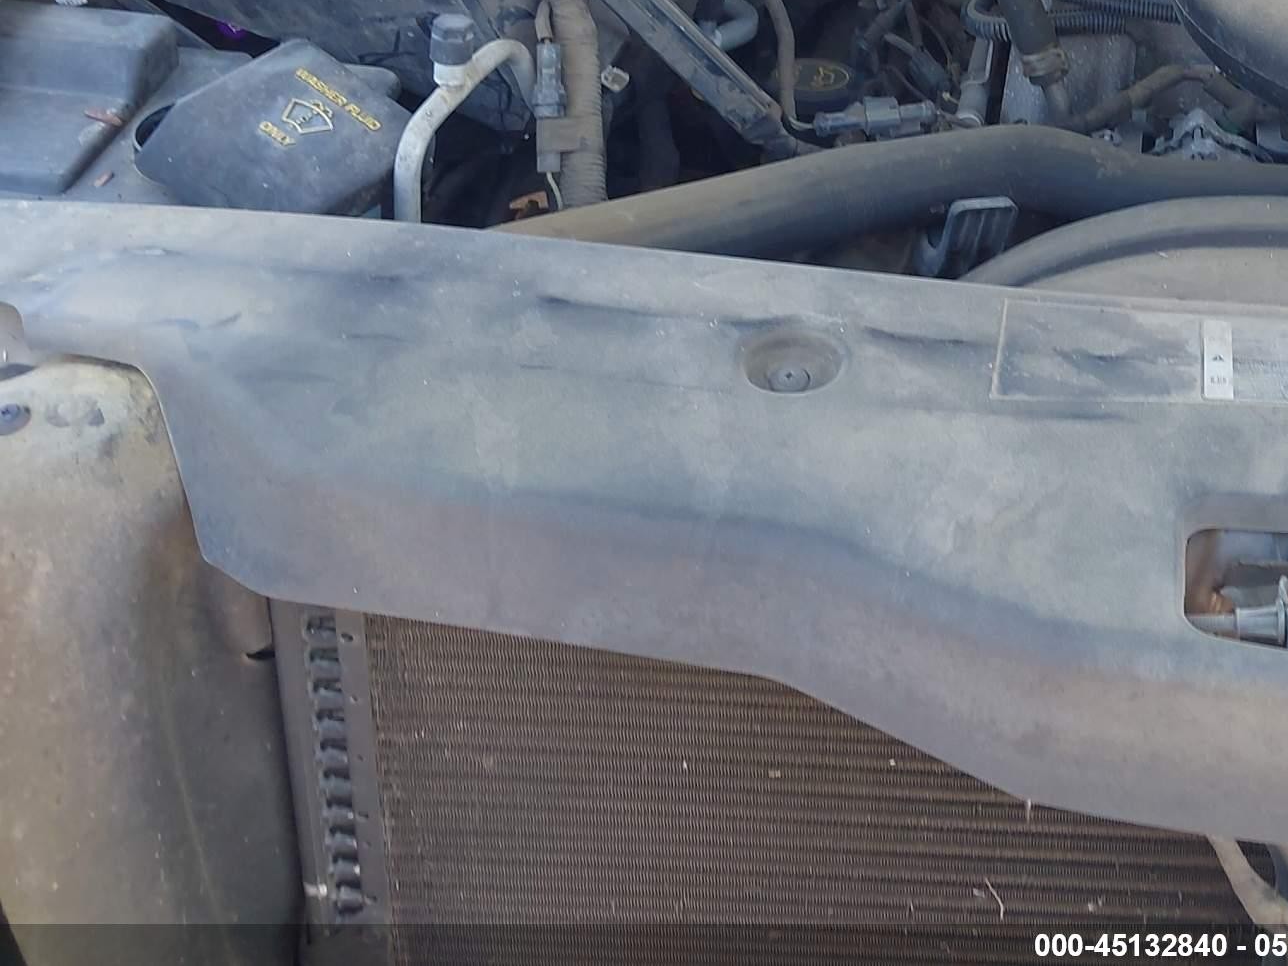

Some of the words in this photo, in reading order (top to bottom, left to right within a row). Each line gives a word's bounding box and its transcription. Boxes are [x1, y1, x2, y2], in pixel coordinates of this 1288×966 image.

[295, 67, 348, 107] WASHER
[344, 103, 381, 131] FLUID
[259, 121, 297, 147] ONLY
